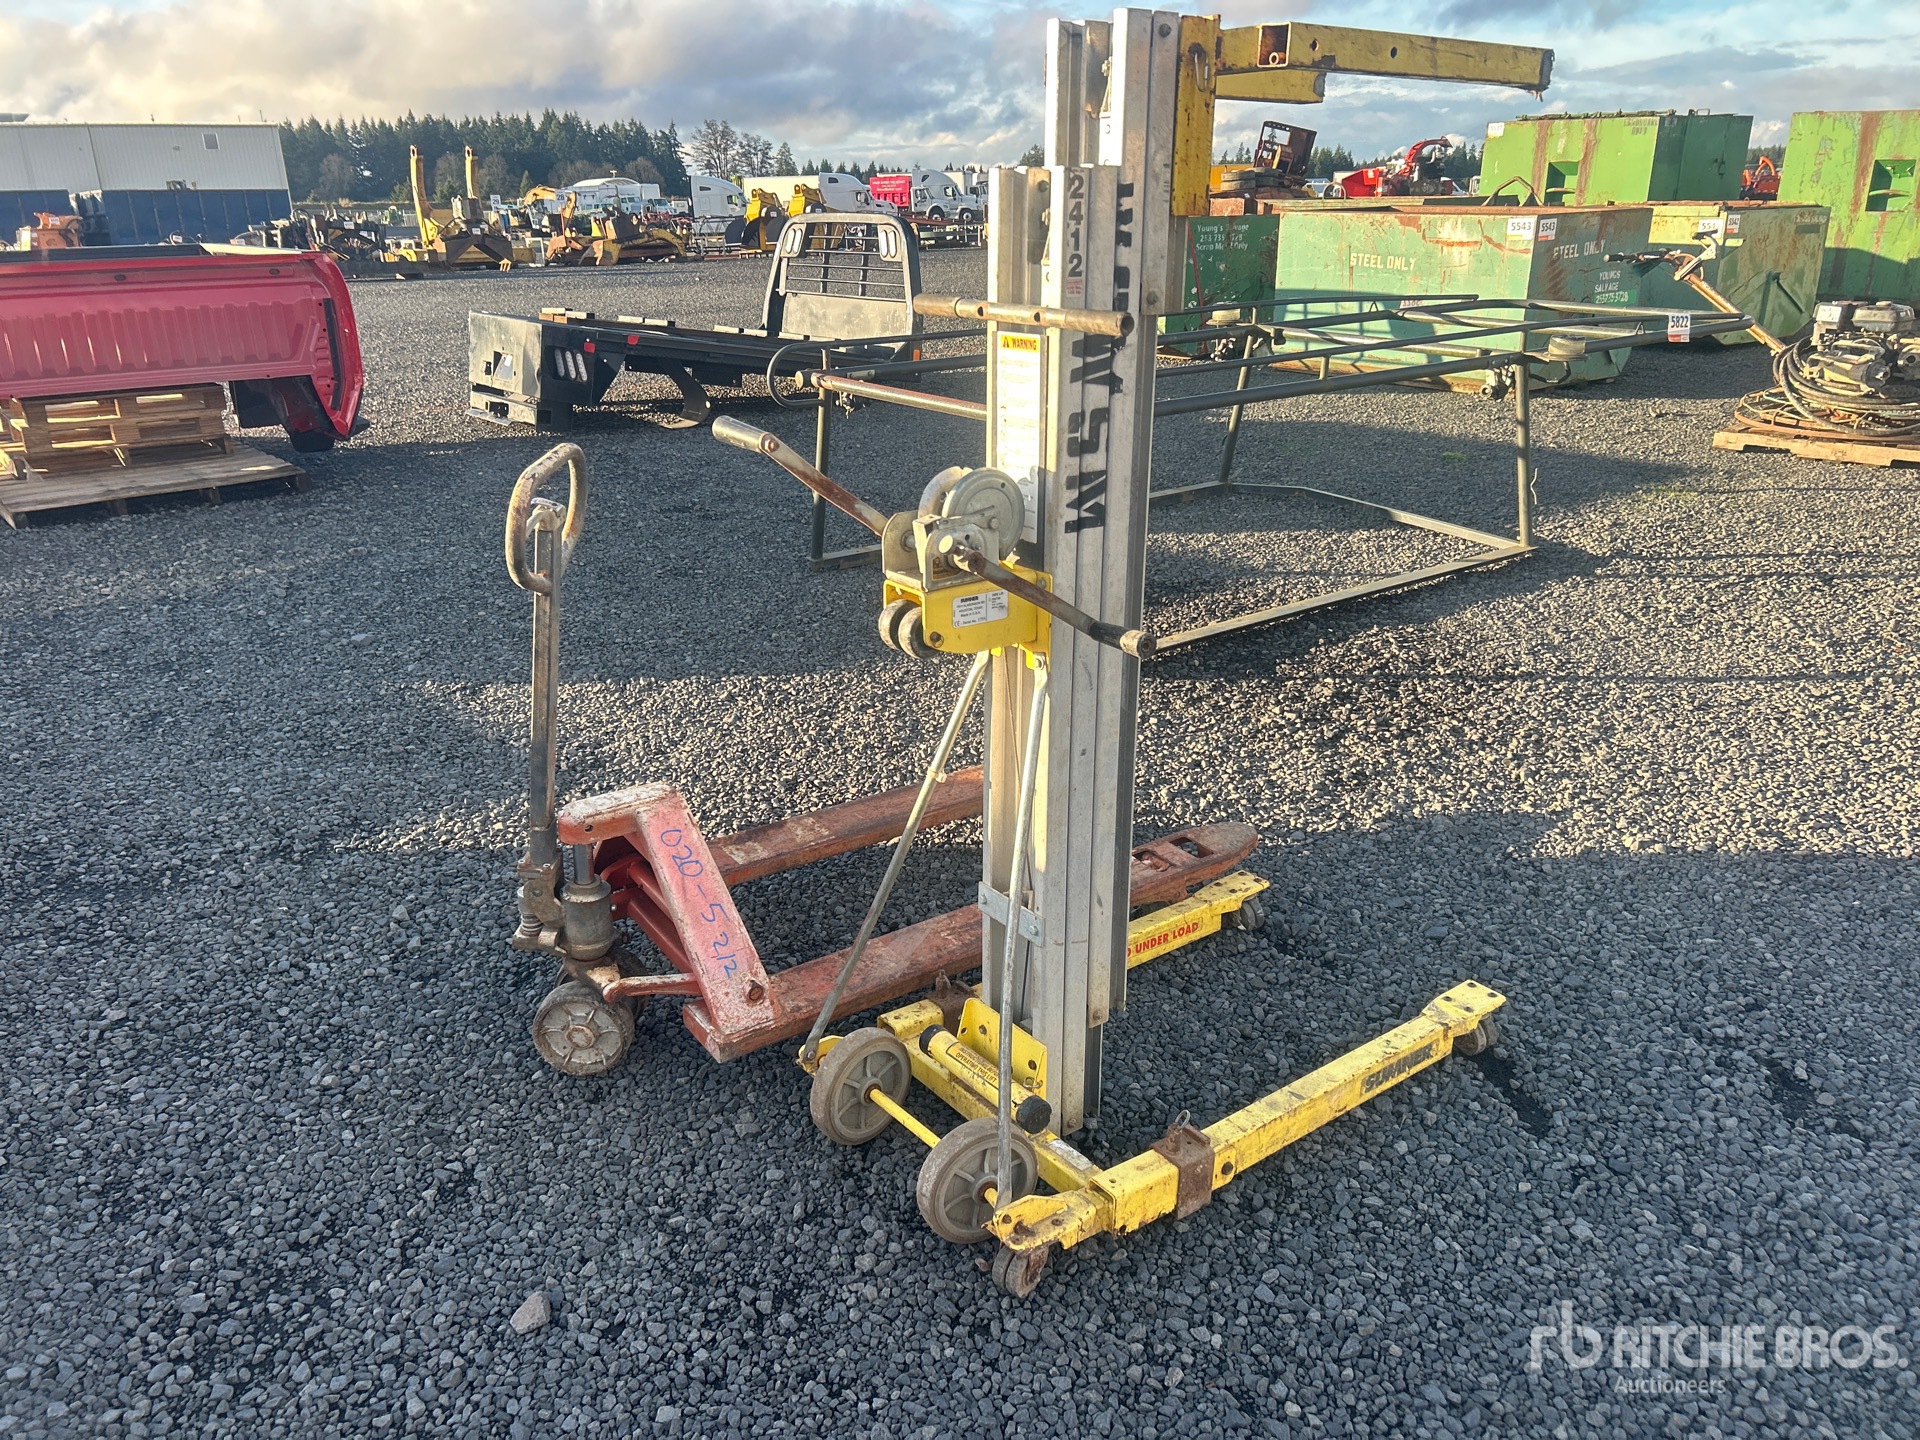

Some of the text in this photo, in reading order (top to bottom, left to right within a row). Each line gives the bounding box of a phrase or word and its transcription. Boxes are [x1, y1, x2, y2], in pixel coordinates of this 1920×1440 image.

[556, 193, 565, 201] 28
[1068, 174, 1085, 278] 2412
[1511, 222, 1532, 231] 5543
[1541, 222, 1556, 232] 5543
[1553, 240, 1605, 259] STEEL ONLY
[1350, 252, 1416, 271] STEEL ONLY
[1594, 281, 1620, 293] SALVAGE
[1671, 315, 1689, 328] 5822
[1011, 338, 1037, 351] WARNING
[1135, 933, 1169, 954] UNDER
[1172, 921, 1199, 940] LOAD
[955, 1052, 997, 1083] OPERATING THIS LIFT
